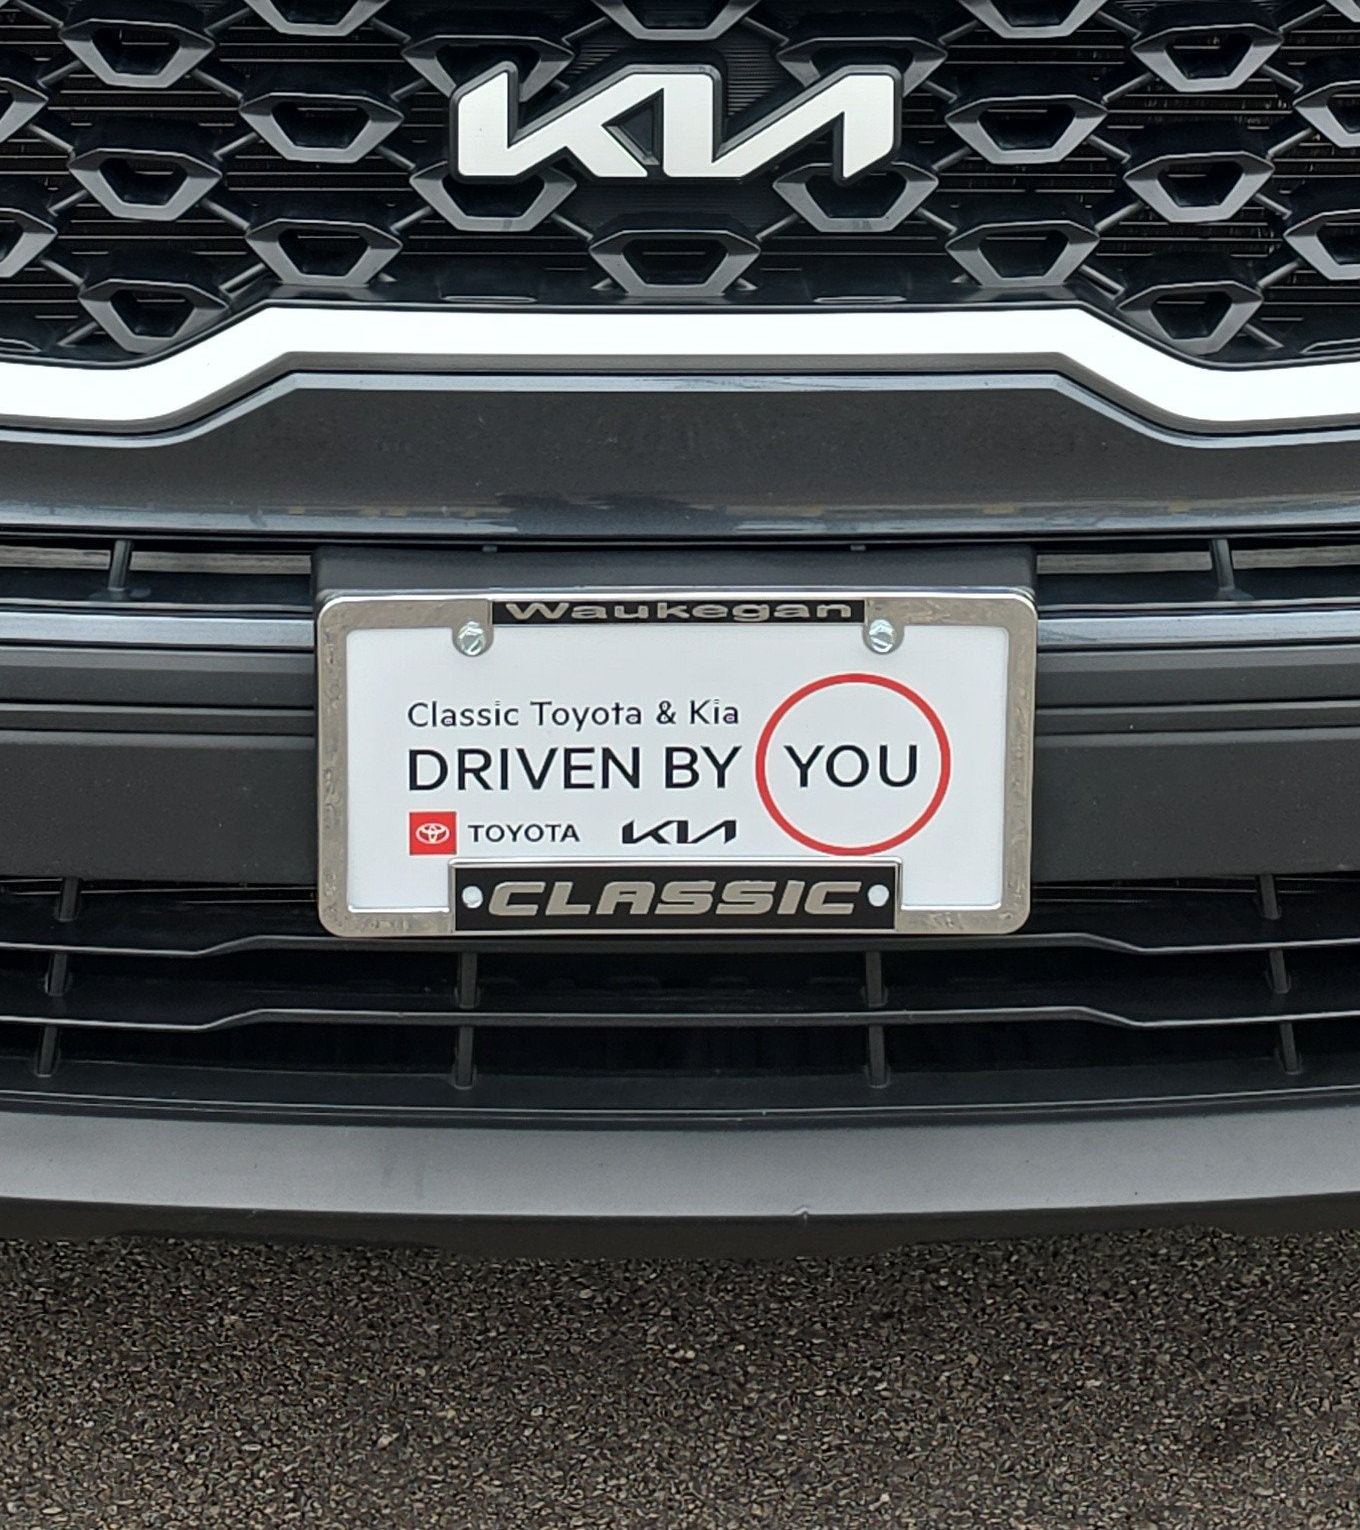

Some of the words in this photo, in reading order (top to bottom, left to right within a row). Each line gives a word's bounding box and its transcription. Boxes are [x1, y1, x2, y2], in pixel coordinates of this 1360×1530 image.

[455, 68, 898, 179] KIA
[506, 601, 852, 622] Waukegan
[407, 700, 520, 729] Classic
[530, 700, 642, 733] Toyota
[655, 701, 678, 728] &
[690, 698, 740, 726] Kia
[407, 746, 641, 791] DRIVEN
[664, 744, 742, 789] BY
[783, 743, 919, 788] YOU
[467, 823, 581, 844] TOYOTA
[621, 818, 738, 846] KIA
[487, 880, 862, 917] CLASSIC
